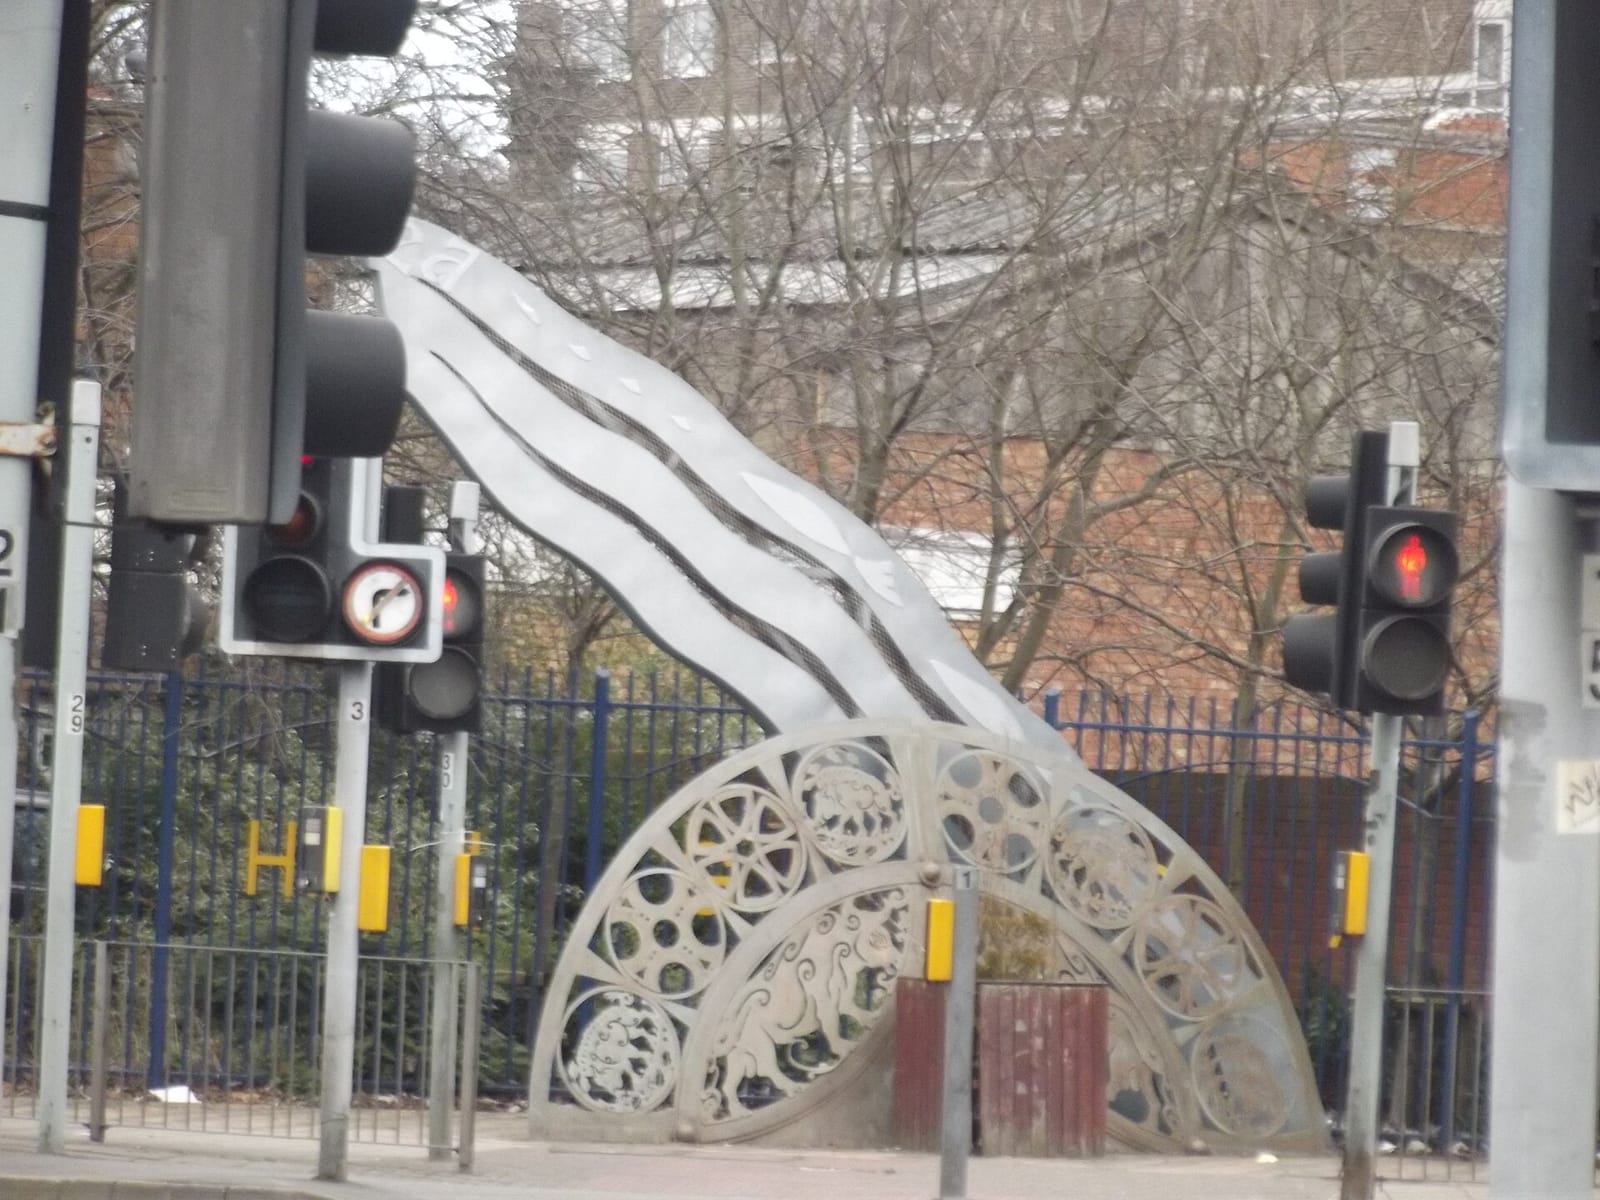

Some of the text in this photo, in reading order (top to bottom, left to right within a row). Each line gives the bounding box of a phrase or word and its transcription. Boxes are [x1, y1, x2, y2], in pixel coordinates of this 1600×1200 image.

[71, 694, 84, 733] 29
[351, 700, 364, 721] 3
[962, 870, 971, 889] 1
